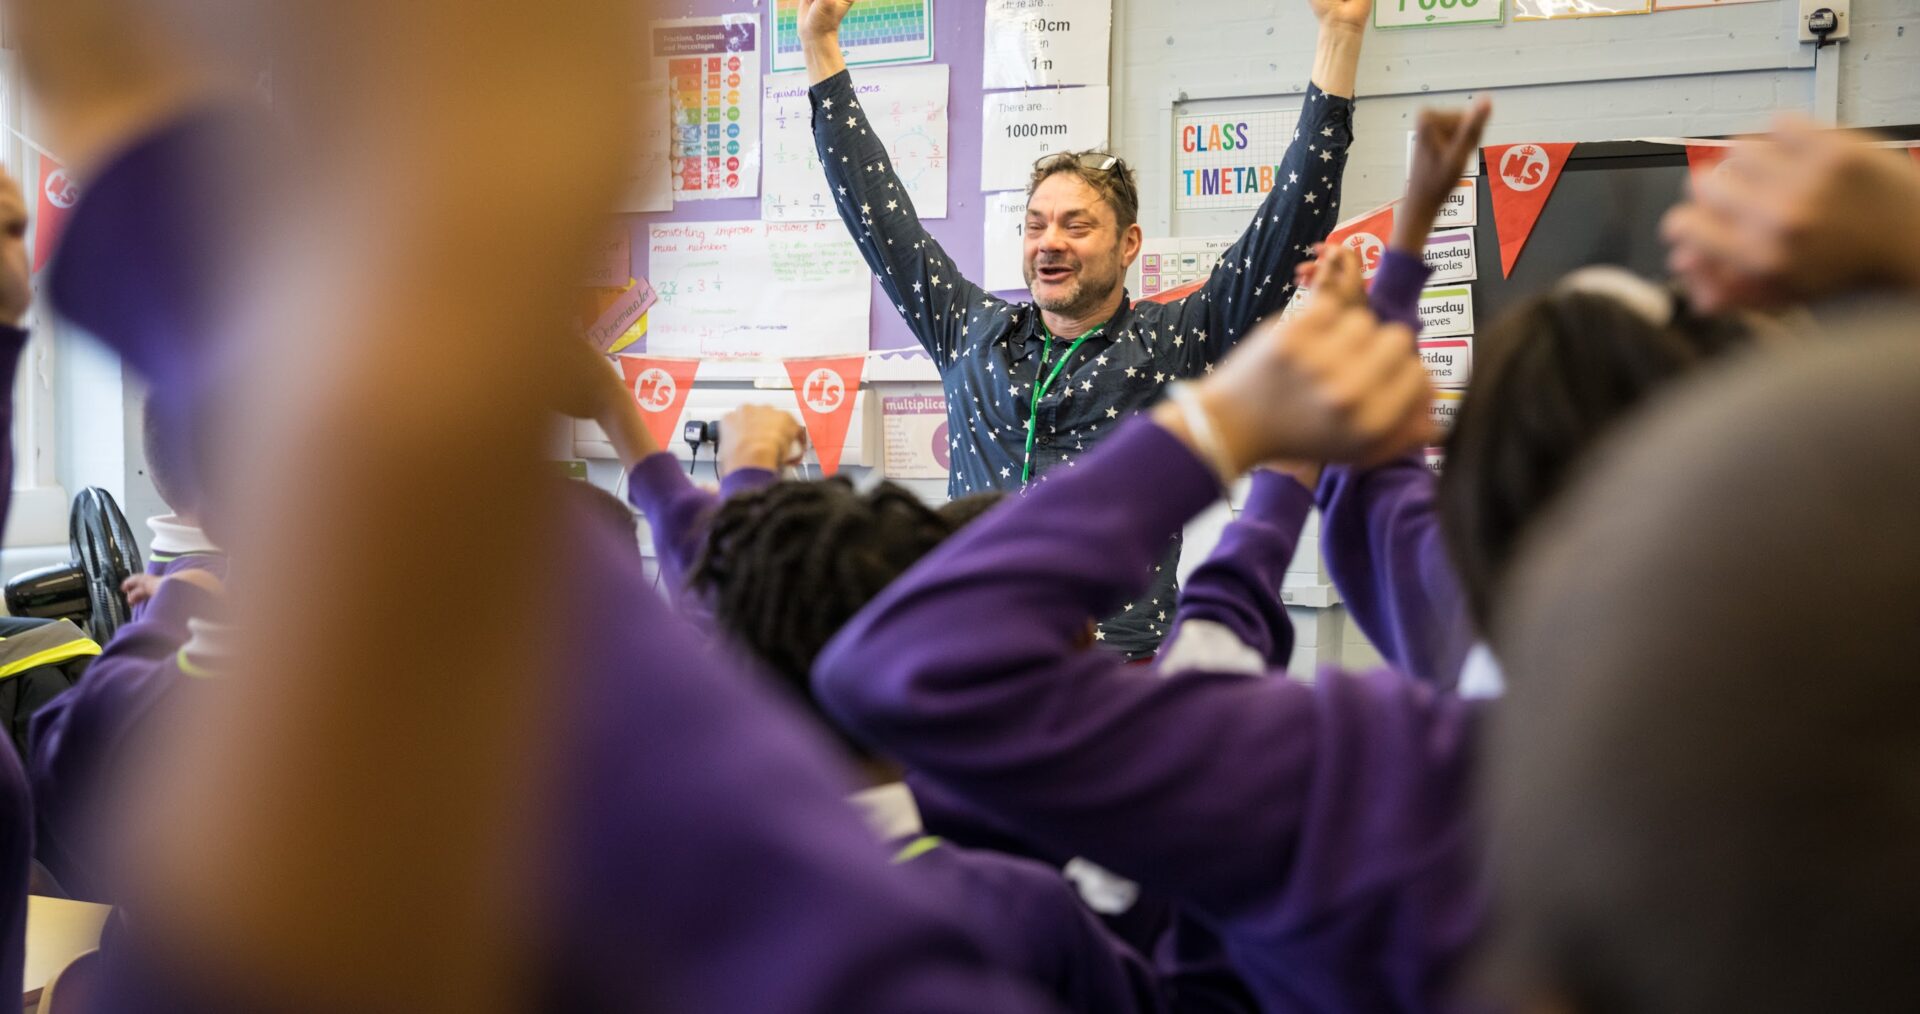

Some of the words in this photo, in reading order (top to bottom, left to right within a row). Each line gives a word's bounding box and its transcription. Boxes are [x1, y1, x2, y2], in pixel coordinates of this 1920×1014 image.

[696, 31, 725, 41] Decimals
[677, 42, 715, 52] Percentages
[998, 103, 1024, 113] There
[1183, 122, 1248, 153] CLASS
[1039, 141, 1049, 152] in
[815, 220, 827, 231] to
[590, 288, 651, 346] Denominator
